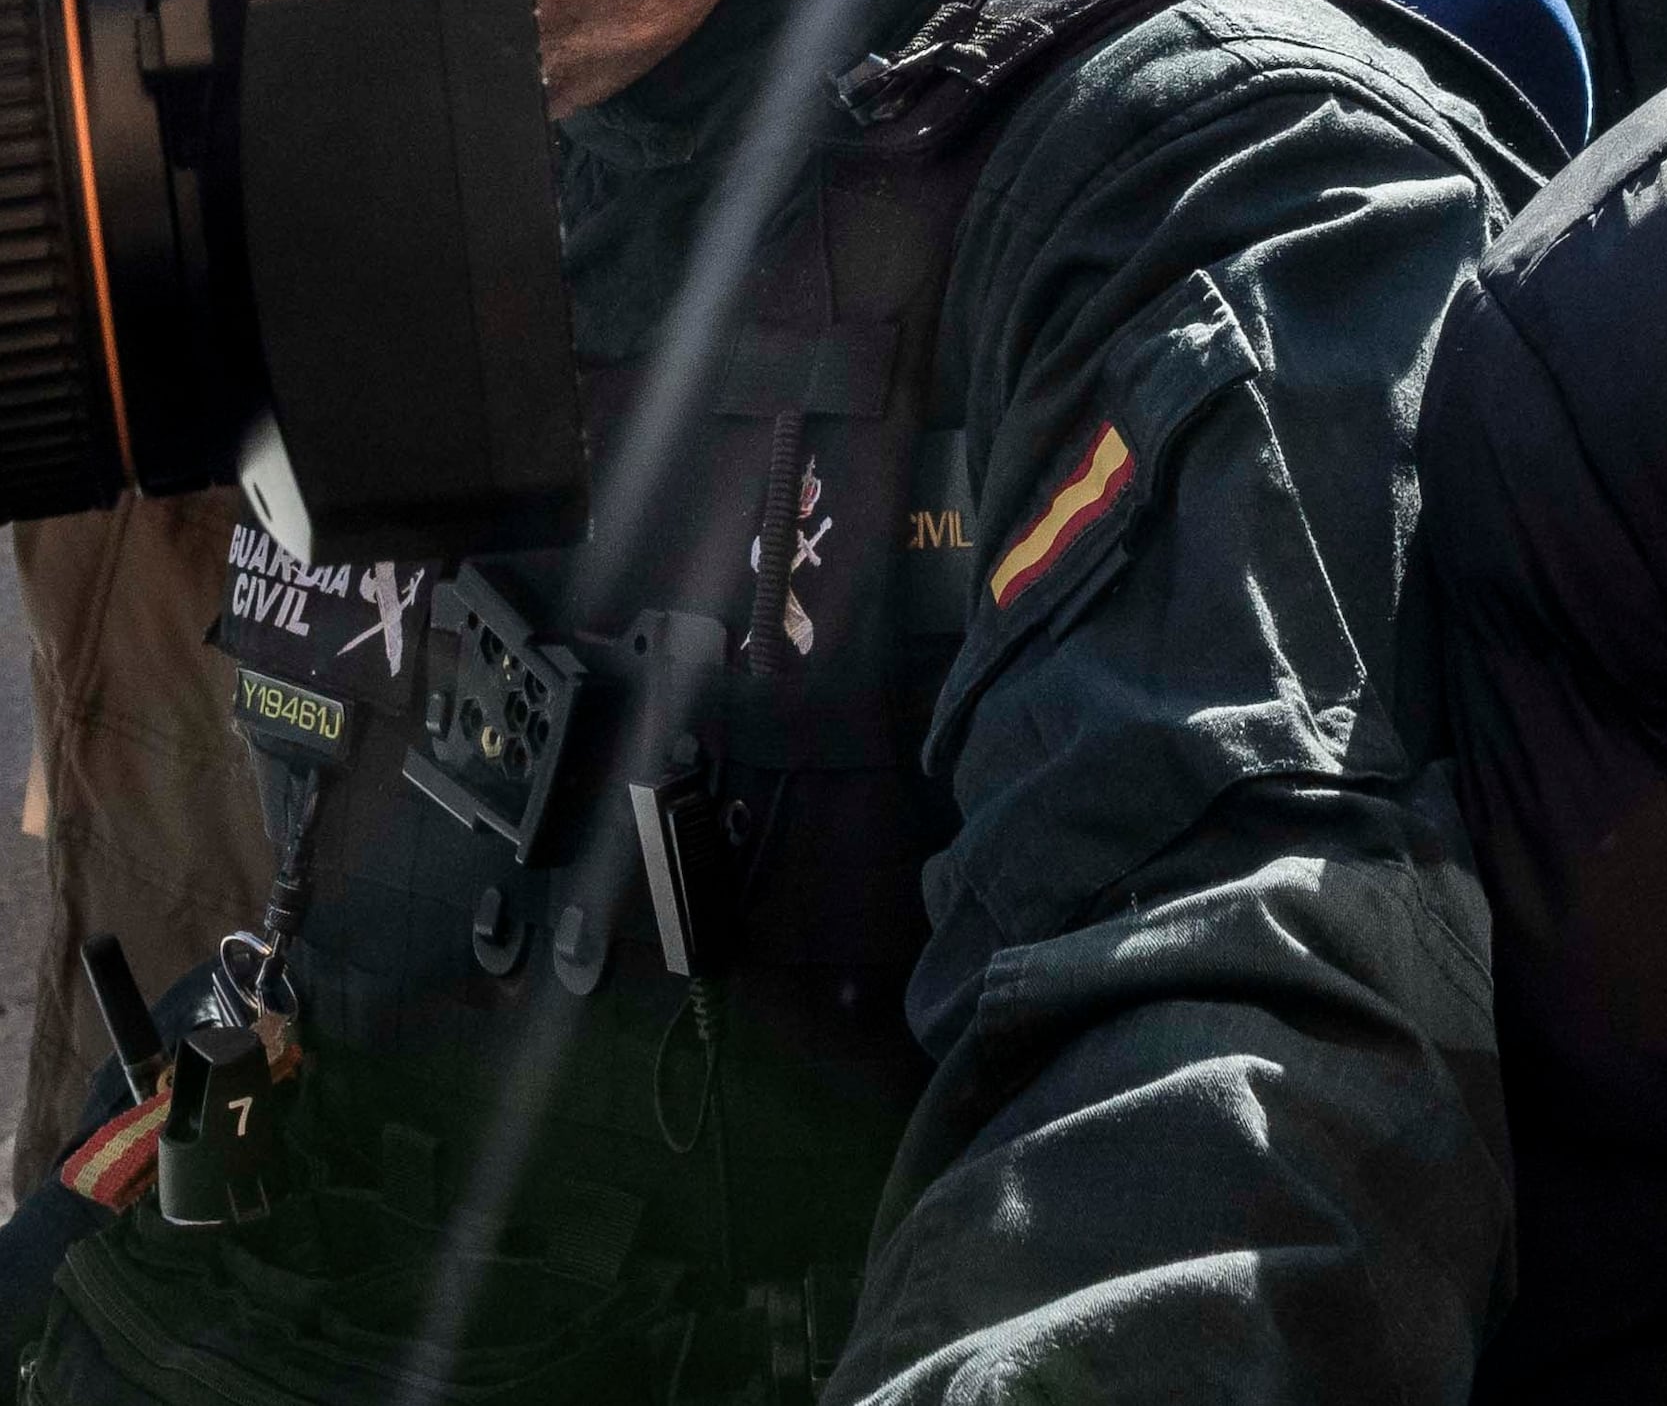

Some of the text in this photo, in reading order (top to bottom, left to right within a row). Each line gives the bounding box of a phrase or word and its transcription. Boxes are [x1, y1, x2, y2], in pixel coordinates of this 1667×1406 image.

[232, 572, 310, 637] CIVIL
[243, 679, 341, 740] Y19461J
[228, 1096, 253, 1136] 7
